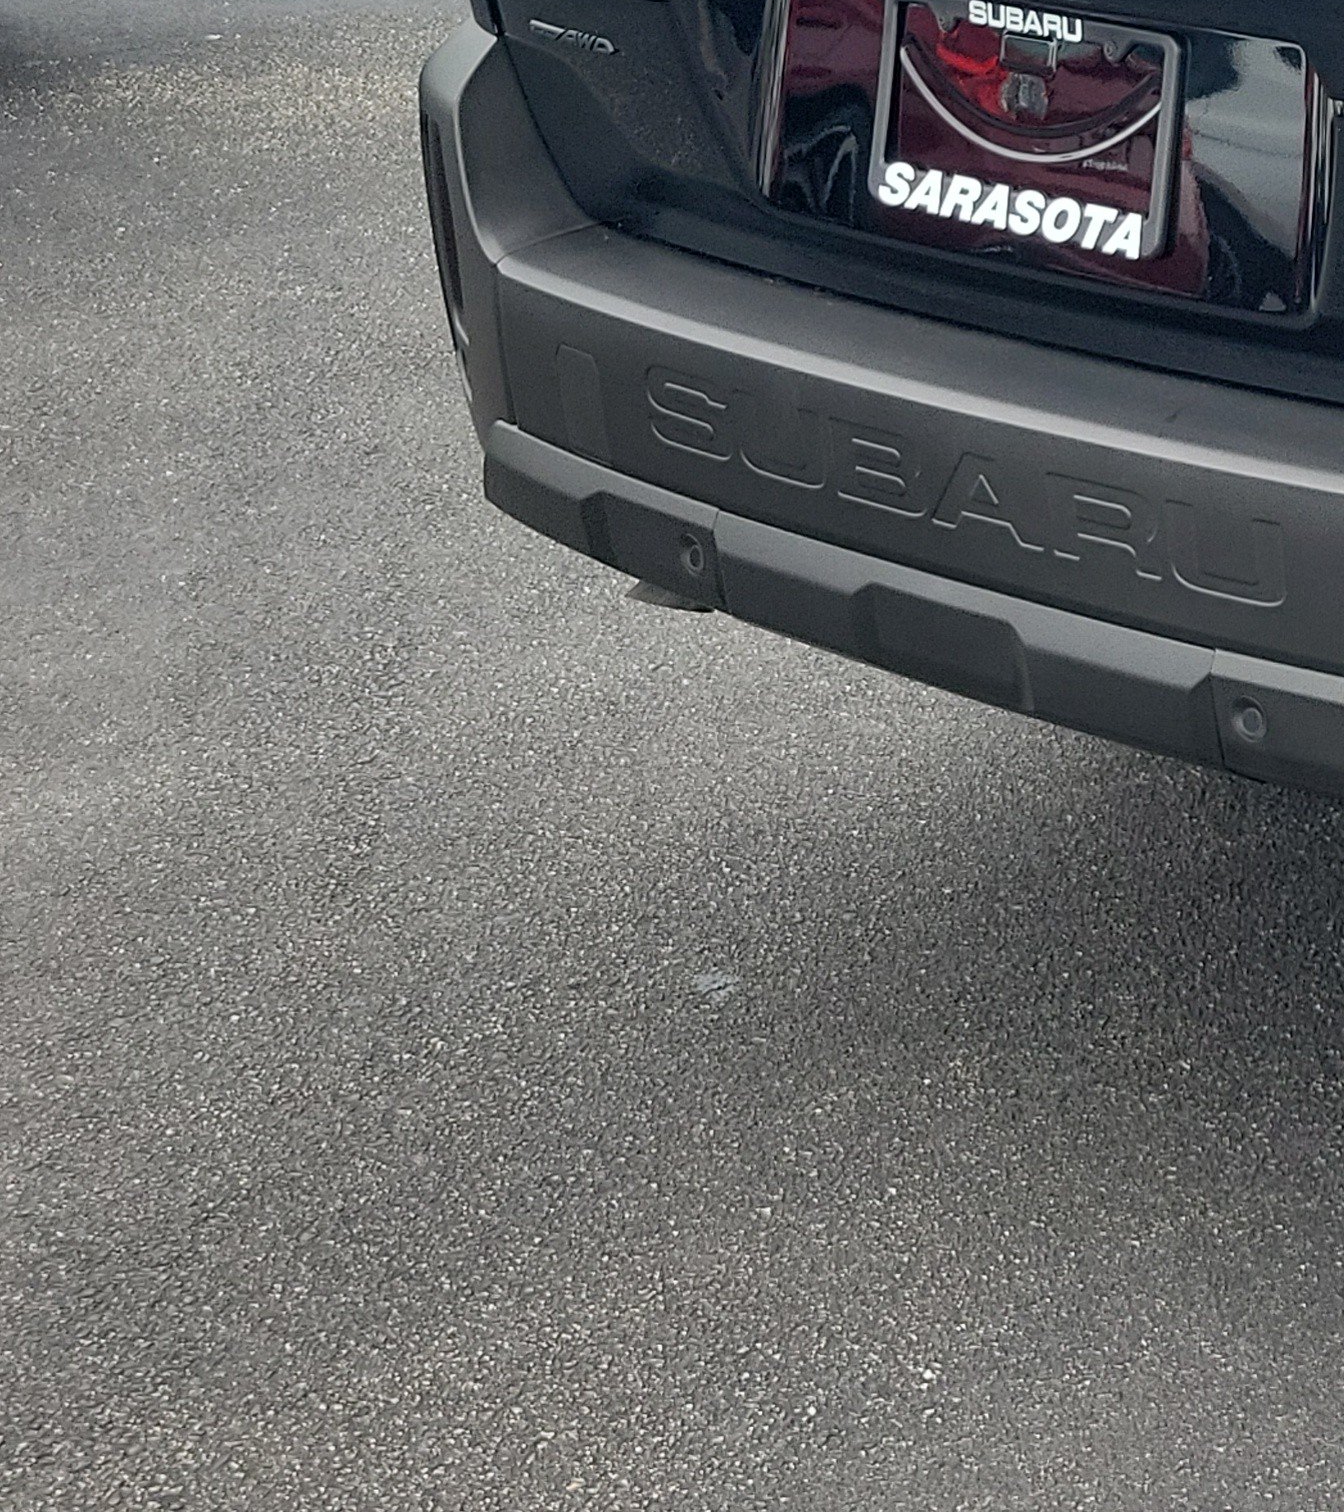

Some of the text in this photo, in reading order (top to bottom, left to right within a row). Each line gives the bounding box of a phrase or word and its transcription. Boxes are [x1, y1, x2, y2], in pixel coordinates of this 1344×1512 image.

[967, 0, 1084, 43] SUBARU
[877, 160, 1144, 261] SARASOTA
[645, 364, 1288, 608] SUBARU
